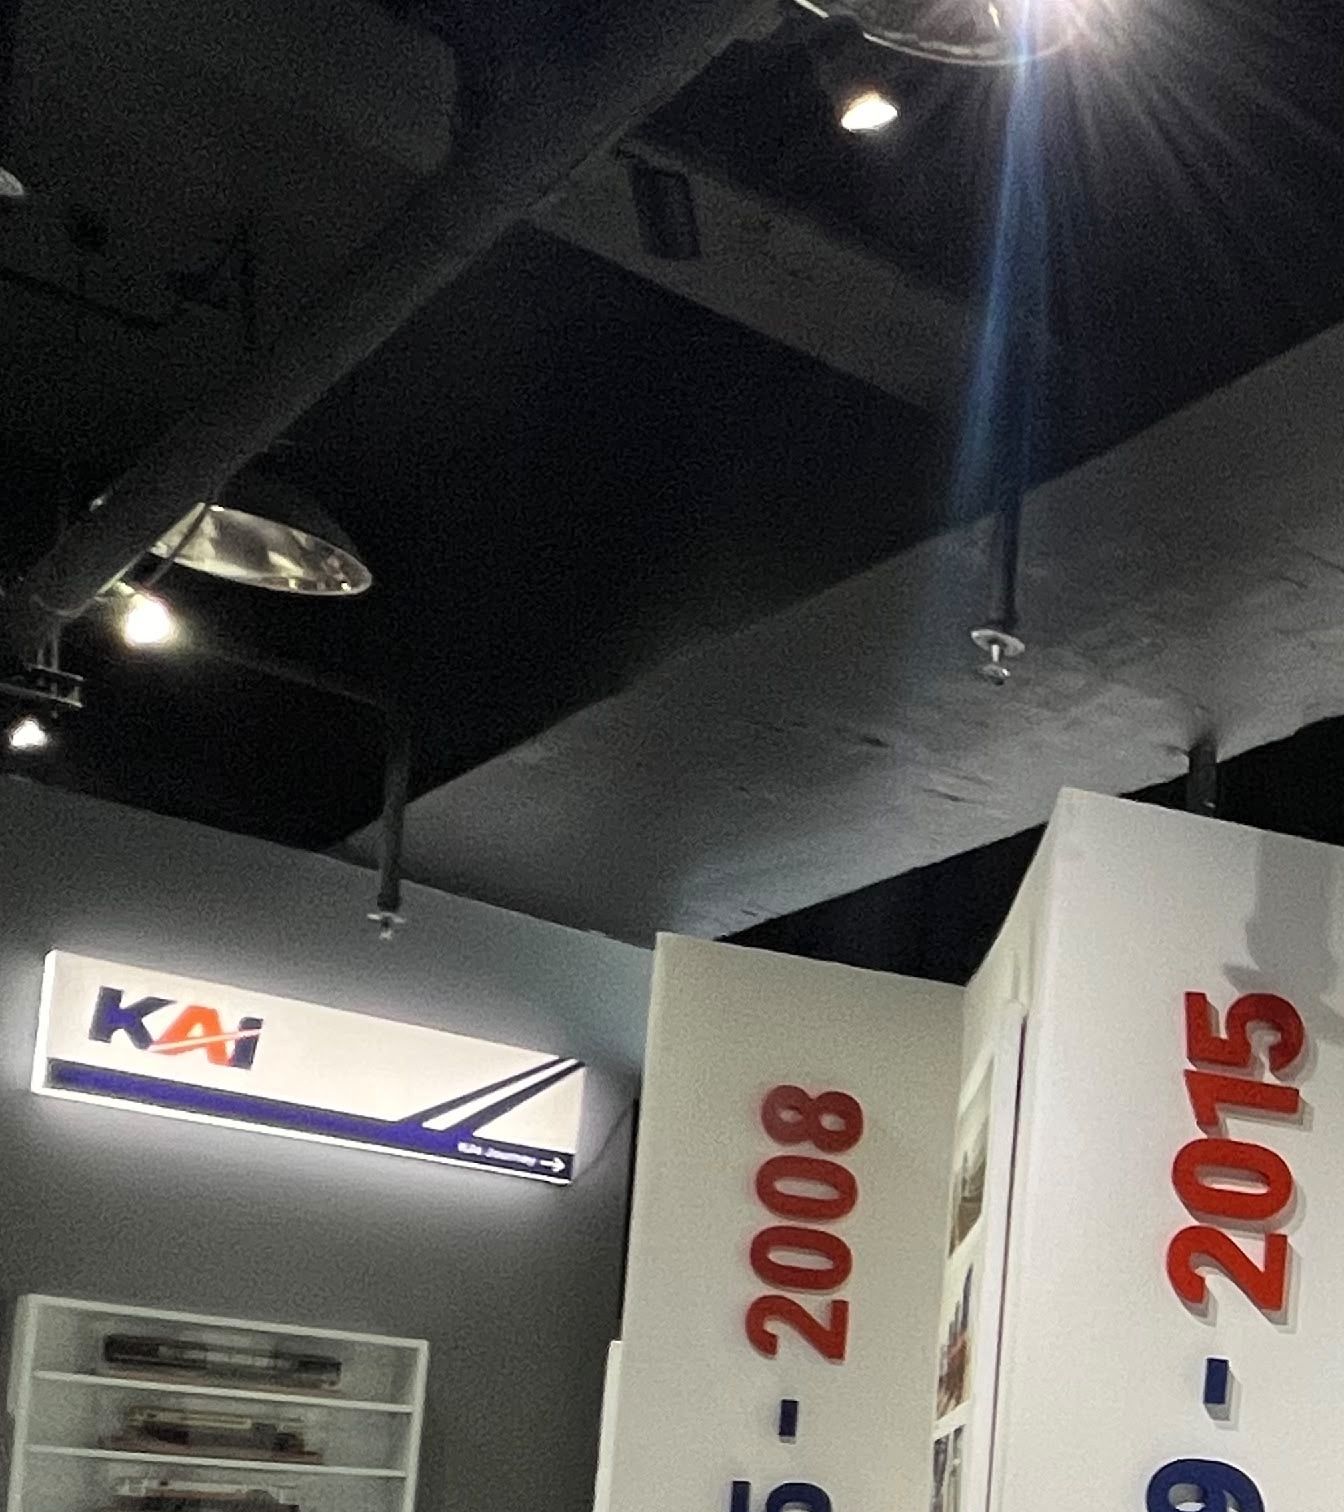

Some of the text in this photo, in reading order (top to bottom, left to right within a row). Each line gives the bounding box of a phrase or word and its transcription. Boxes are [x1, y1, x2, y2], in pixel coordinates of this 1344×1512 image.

[89, 985, 264, 1070] KAI
[1166, 991, 1305, 1313] 2015
[745, 1084, 864, 1362] 2008
[779, 1399, 799, 1438] -
[1204, 1357, 1229, 1404] -
